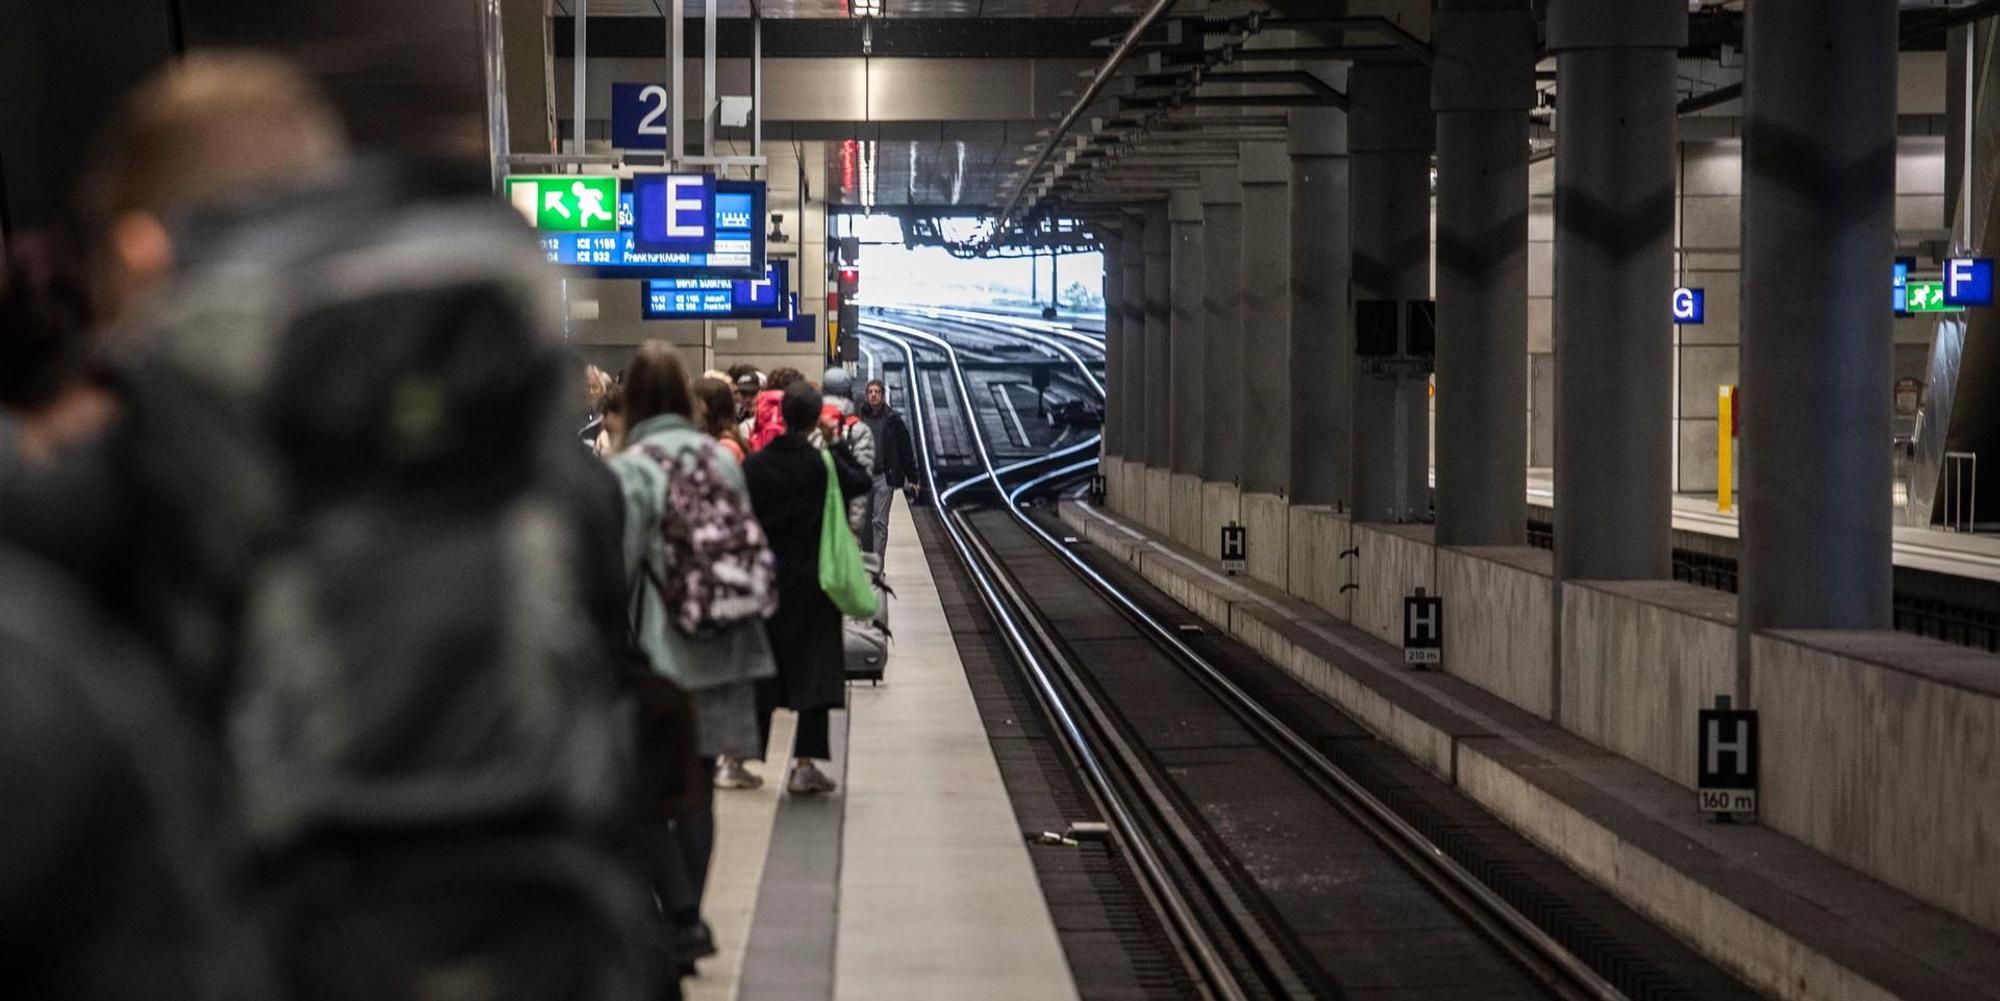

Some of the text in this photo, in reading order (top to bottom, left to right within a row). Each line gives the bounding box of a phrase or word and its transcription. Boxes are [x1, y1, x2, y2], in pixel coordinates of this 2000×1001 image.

[638, 85, 667, 135] 2
[666, 175, 705, 237] E
[577, 238, 590, 250] ICE
[577, 251, 590, 263] ICE
[1951, 259, 1974, 297] F
[1673, 288, 1693, 318] G
[1092, 477, 1104, 494] H
[1225, 530, 1242, 555] H
[1410, 603, 1436, 639] H
[1408, 650, 1437, 661] 210 m
[1707, 719, 1748, 774] H
[1703, 791, 1753, 810] 160 m
